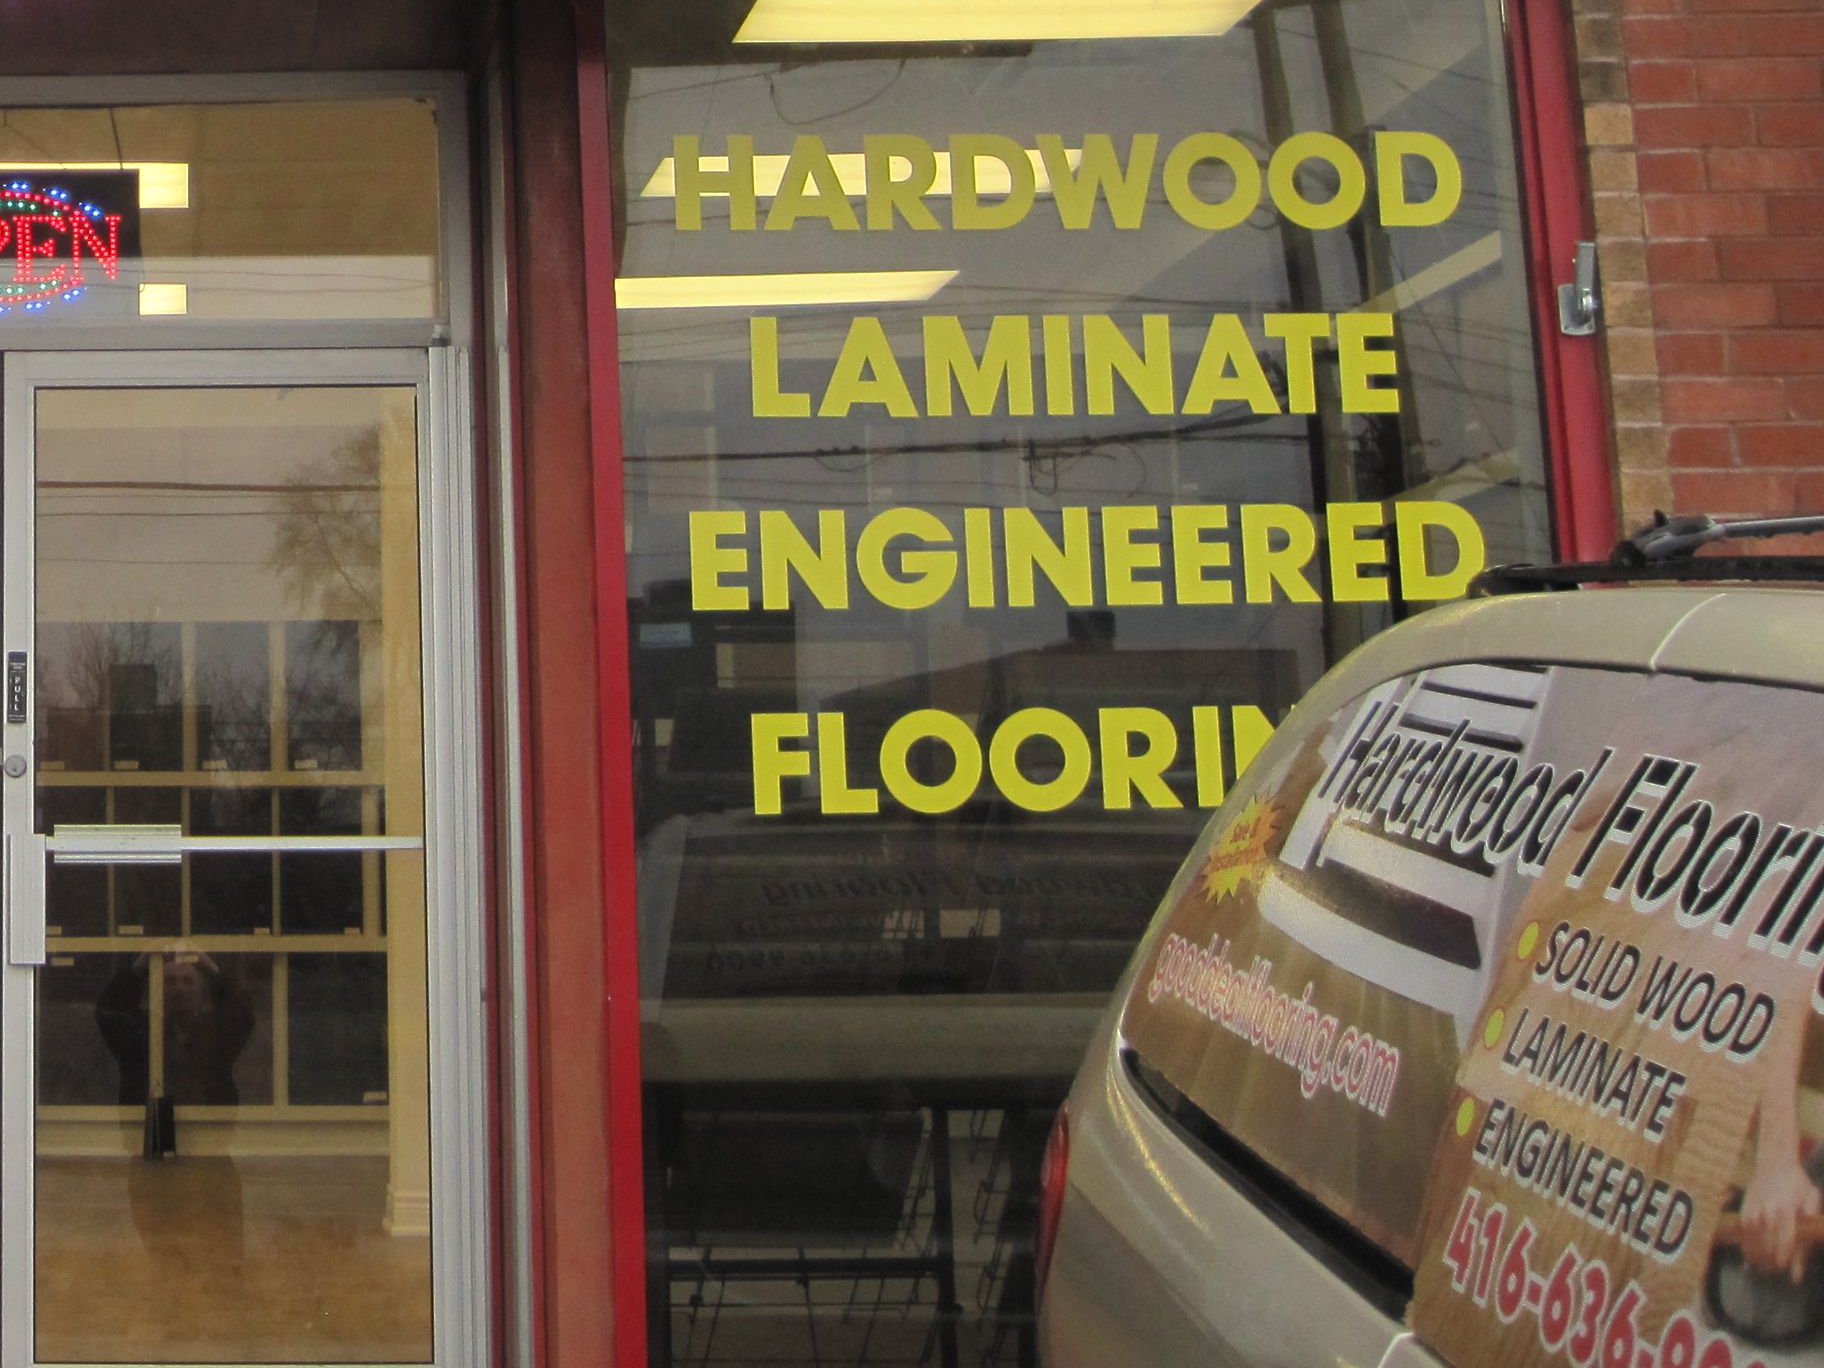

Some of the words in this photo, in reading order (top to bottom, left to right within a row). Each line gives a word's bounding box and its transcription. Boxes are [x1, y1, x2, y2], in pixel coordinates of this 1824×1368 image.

[673, 132, 1462, 230] HARDWOOD
[751, 312, 1401, 417] LAMINATE
[689, 500, 1486, 611] ENGINEERED
[1317, 699, 1614, 877] Hardwood
[1566, 753, 1824, 1014] Floori
[1148, 932, 1401, 1119] gooddealflooring.com
[1533, 920, 1641, 1010] SOLID
[1634, 955, 1776, 1064] WOOD
[1501, 1007, 1687, 1143] LAMINATE
[1473, 1098, 1694, 1264] ENGINEERED
[1442, 1185, 1772, 1368] 416-636-9
